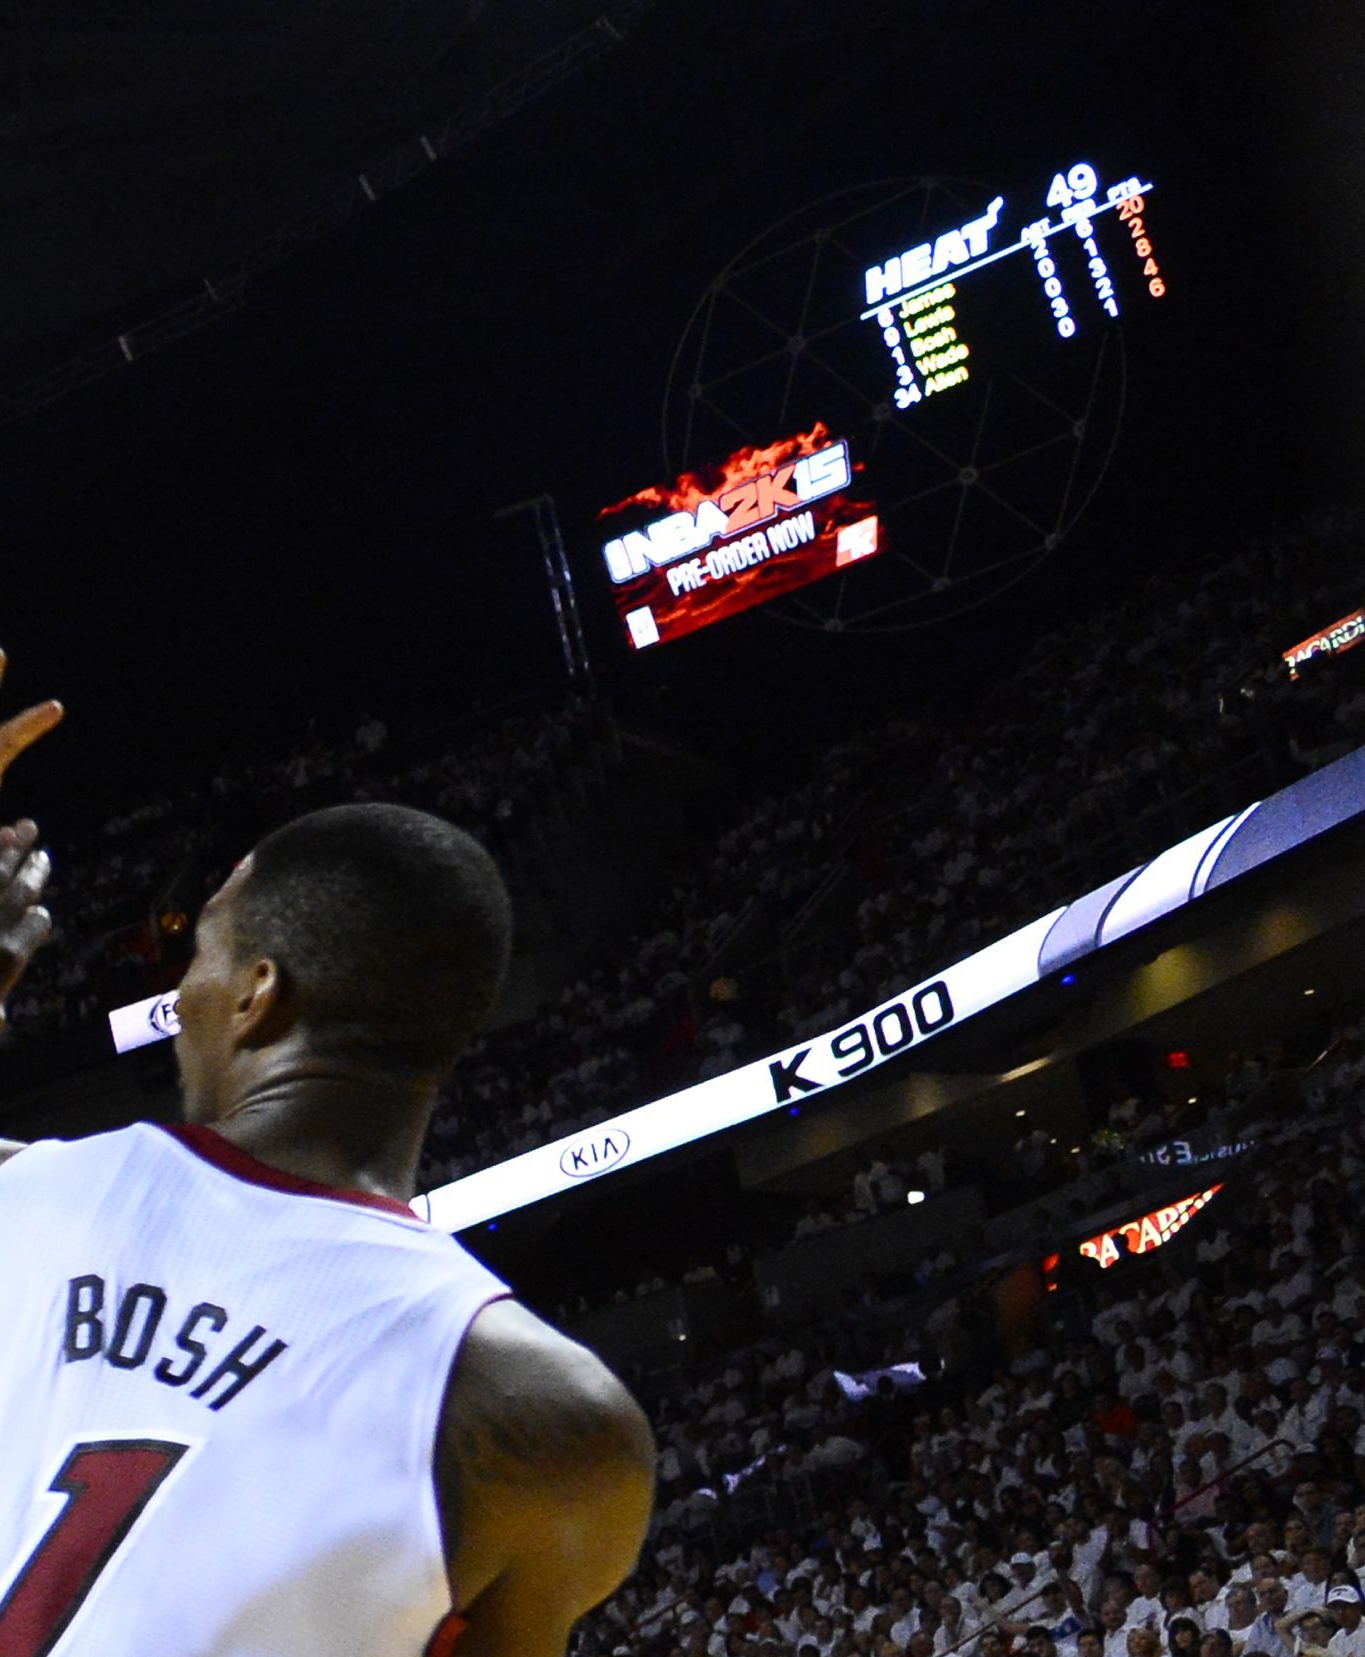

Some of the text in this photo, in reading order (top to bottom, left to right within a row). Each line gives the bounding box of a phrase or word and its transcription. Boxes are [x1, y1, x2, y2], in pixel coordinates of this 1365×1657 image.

[1046, 163, 1098, 208] 49
[1115, 195, 1145, 220] 20
[865, 196, 1004, 304] HEAT
[891, 237, 1152, 365] 1 Bosh 0 3 8
[1037, 256, 1056, 278] 0
[1083, 238, 1098, 257] 1
[1128, 217, 1147, 238] 2
[894, 277, 1165, 409] 34 Allen 0 1 6
[896, 257, 1159, 385] 3 Wade 3 2 4
[666, 510, 816, 597] PRE-ORDER NOW
[769, 979, 956, 1104] K 900
[571, 1136, 620, 1171] KIA
[63, 1273, 289, 1412] BOSH
